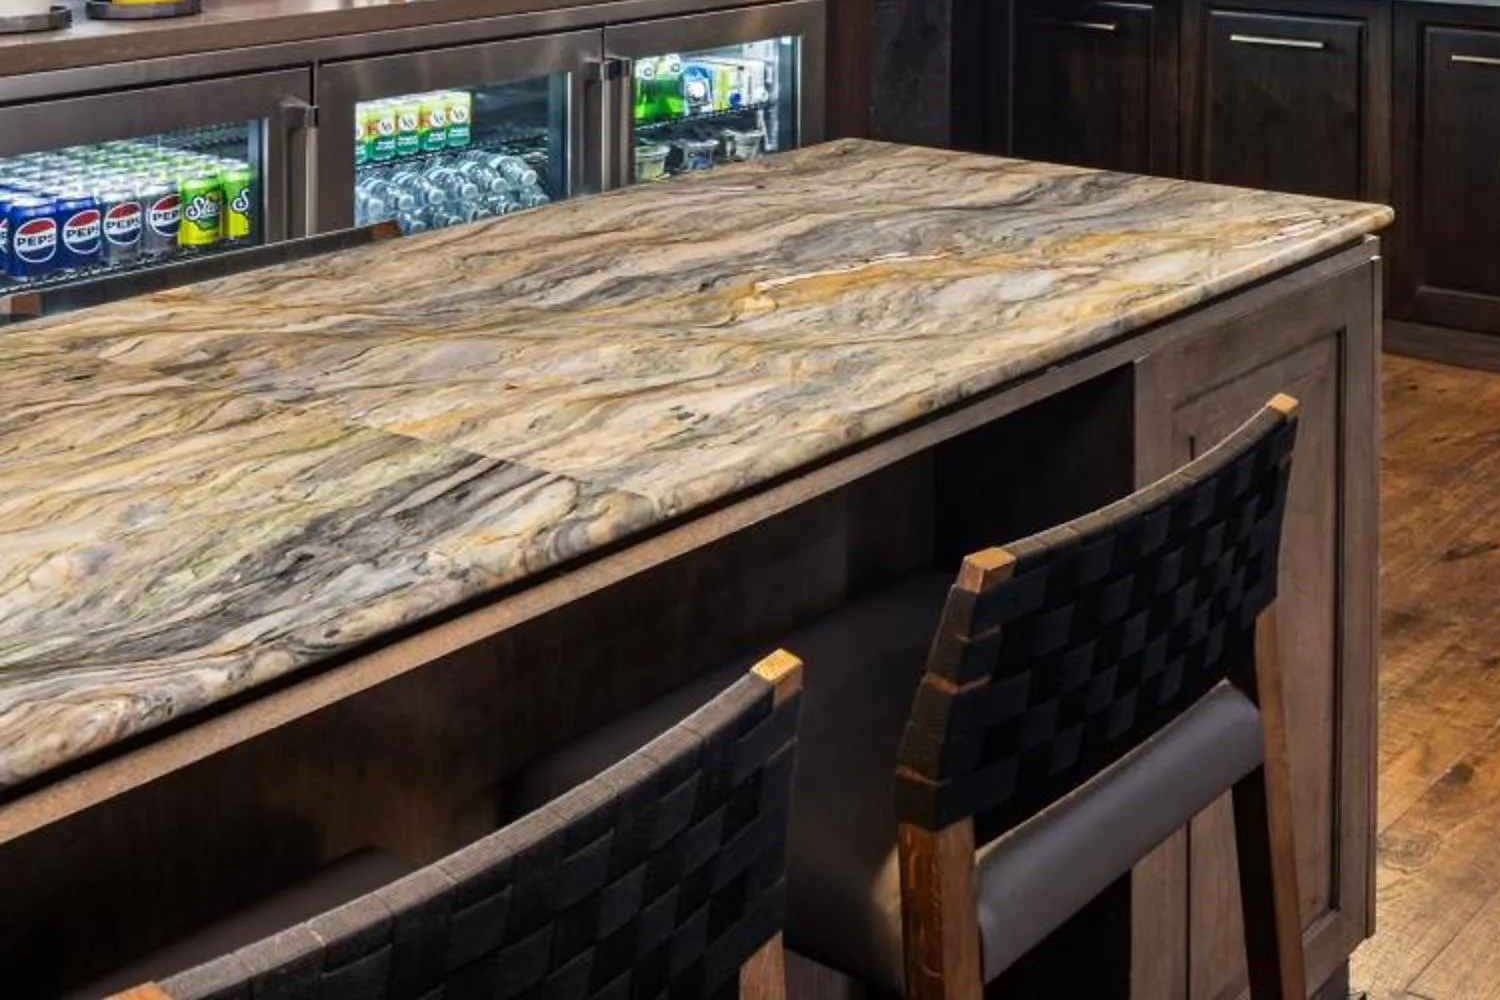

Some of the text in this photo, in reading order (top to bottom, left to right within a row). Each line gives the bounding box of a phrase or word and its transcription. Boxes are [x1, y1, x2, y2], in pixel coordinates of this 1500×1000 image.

[152, 210, 179, 222] PEP
[105, 218, 140, 230] PEPS
[17, 234, 56, 246] PEPS
